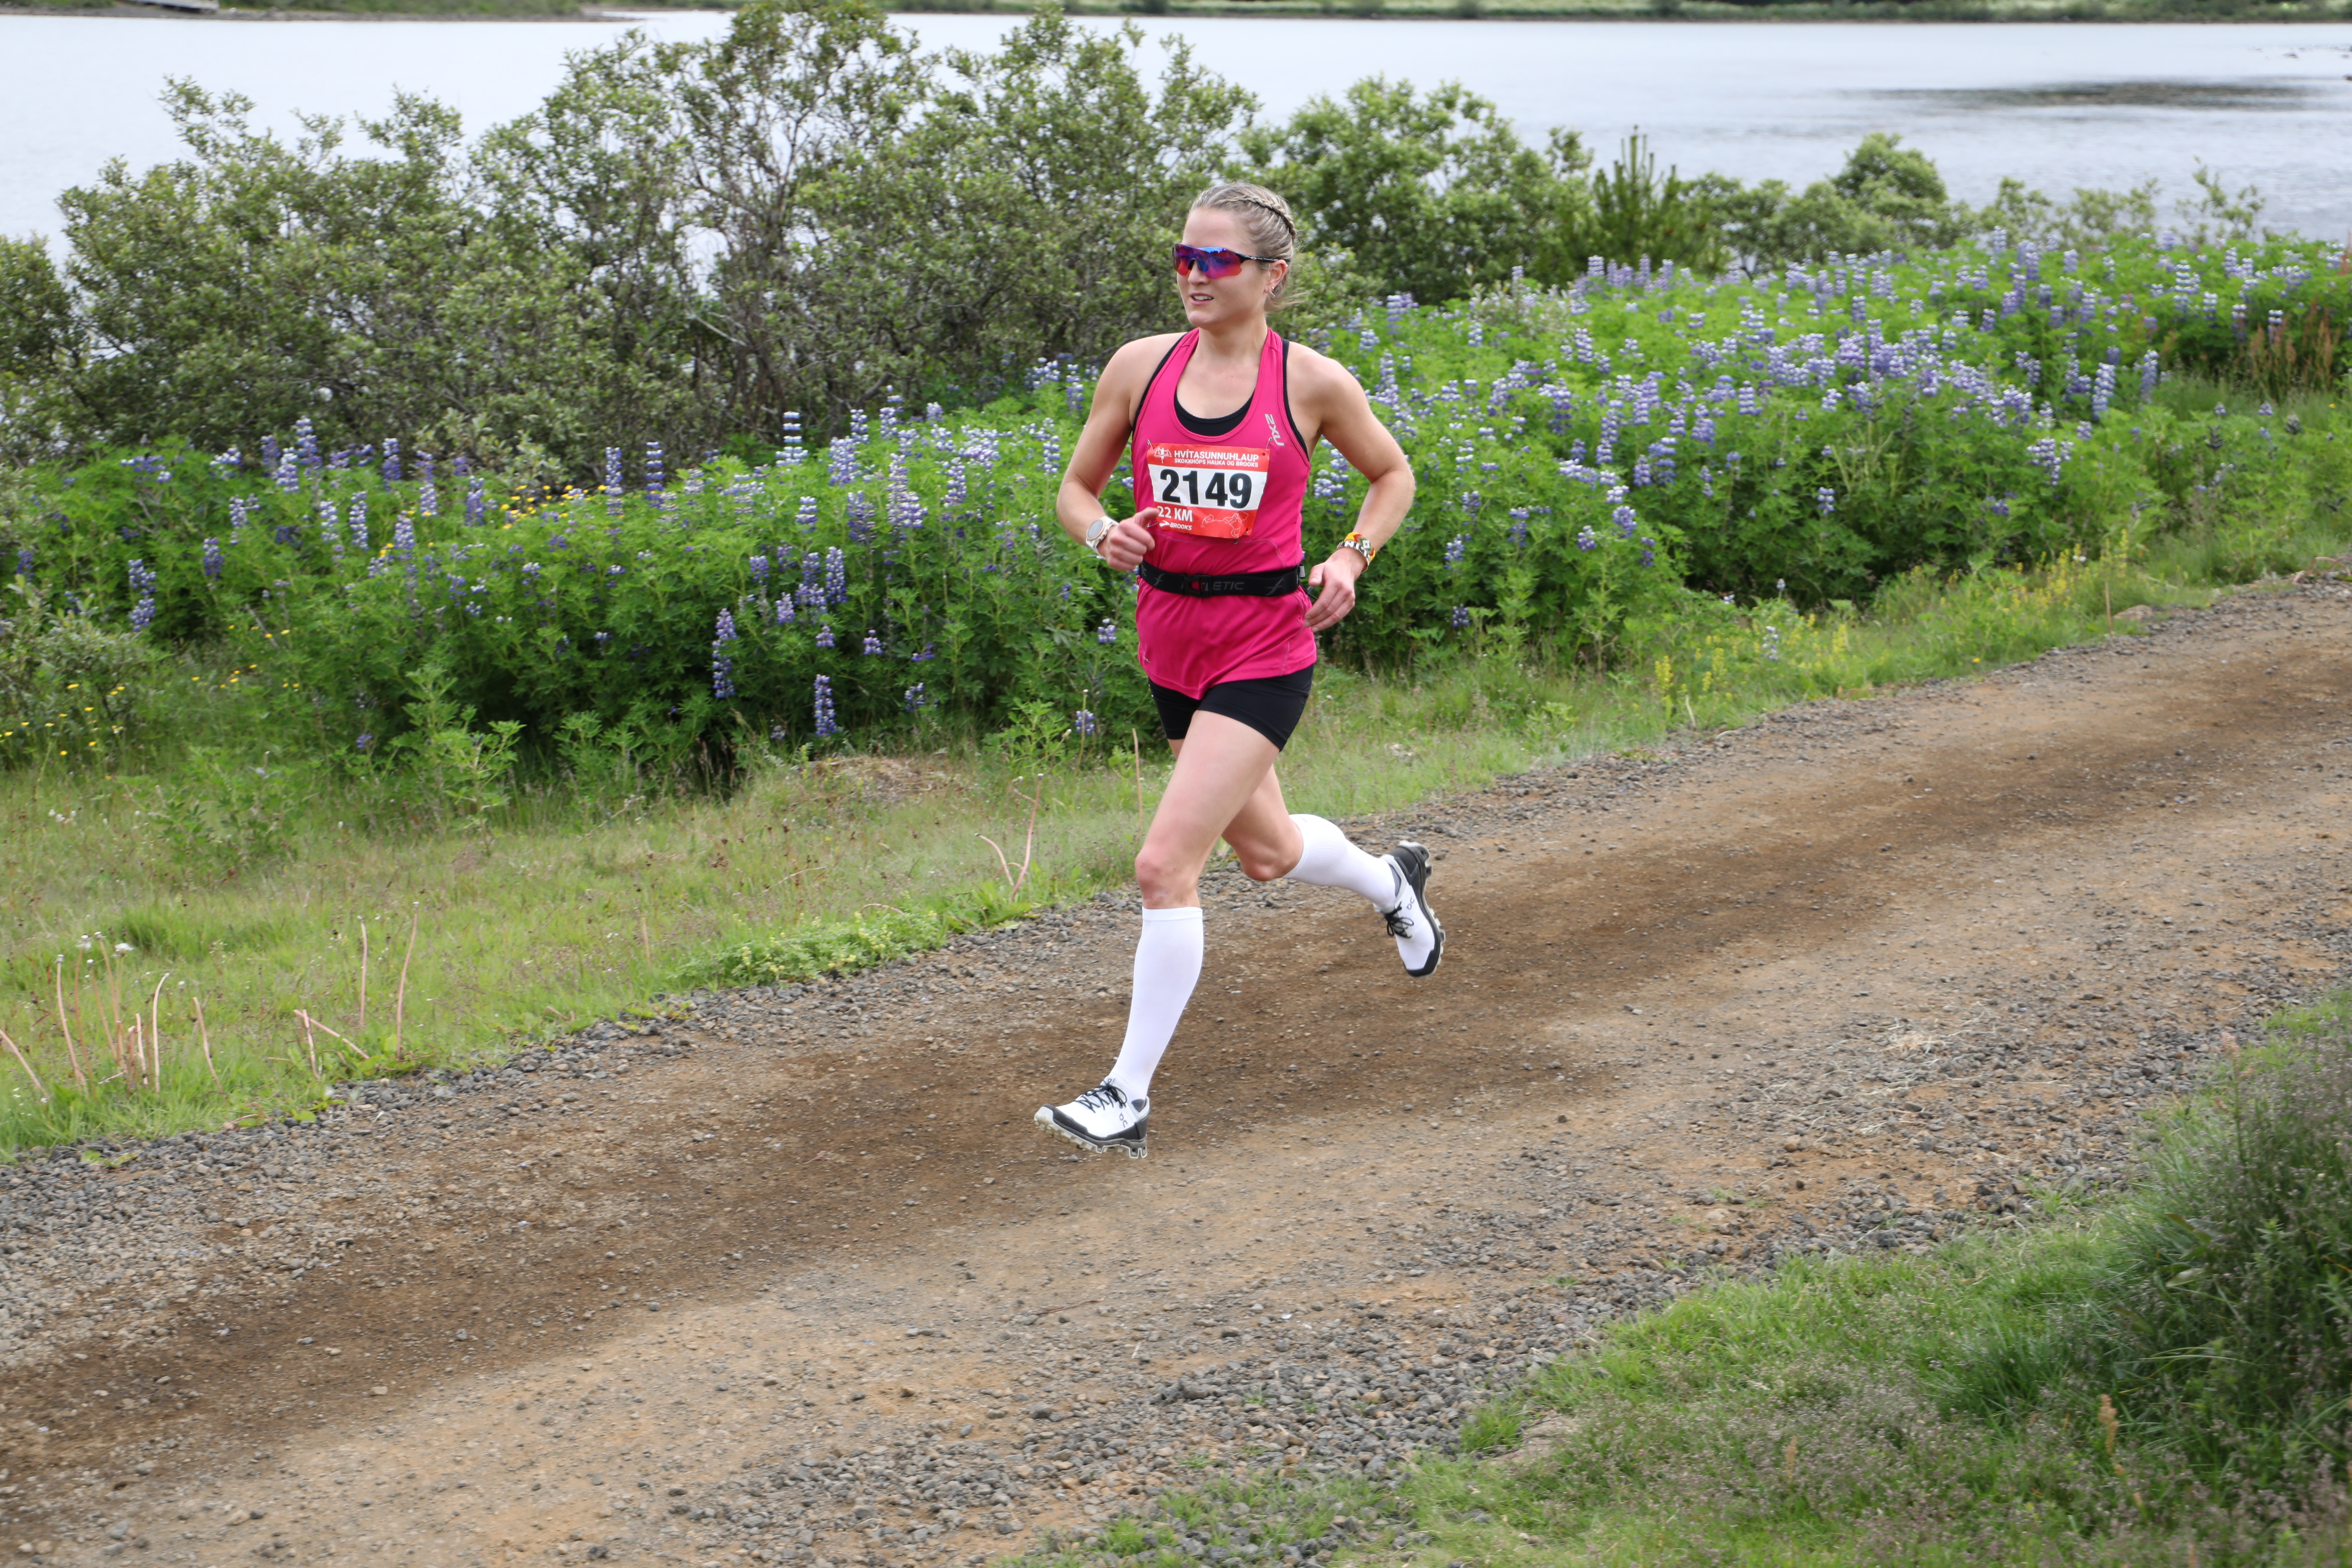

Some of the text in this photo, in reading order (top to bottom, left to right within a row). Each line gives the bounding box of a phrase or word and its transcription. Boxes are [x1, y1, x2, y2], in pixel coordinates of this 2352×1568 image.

[1265, 414, 1285, 446] 2XU
[1174, 449, 1259, 462] HVÍTASUNNUHLAUP
[1160, 468, 1252, 509] 2149
[1157, 505, 1193, 522] 22 KM
[1170, 522, 1192, 531] BROOKS
